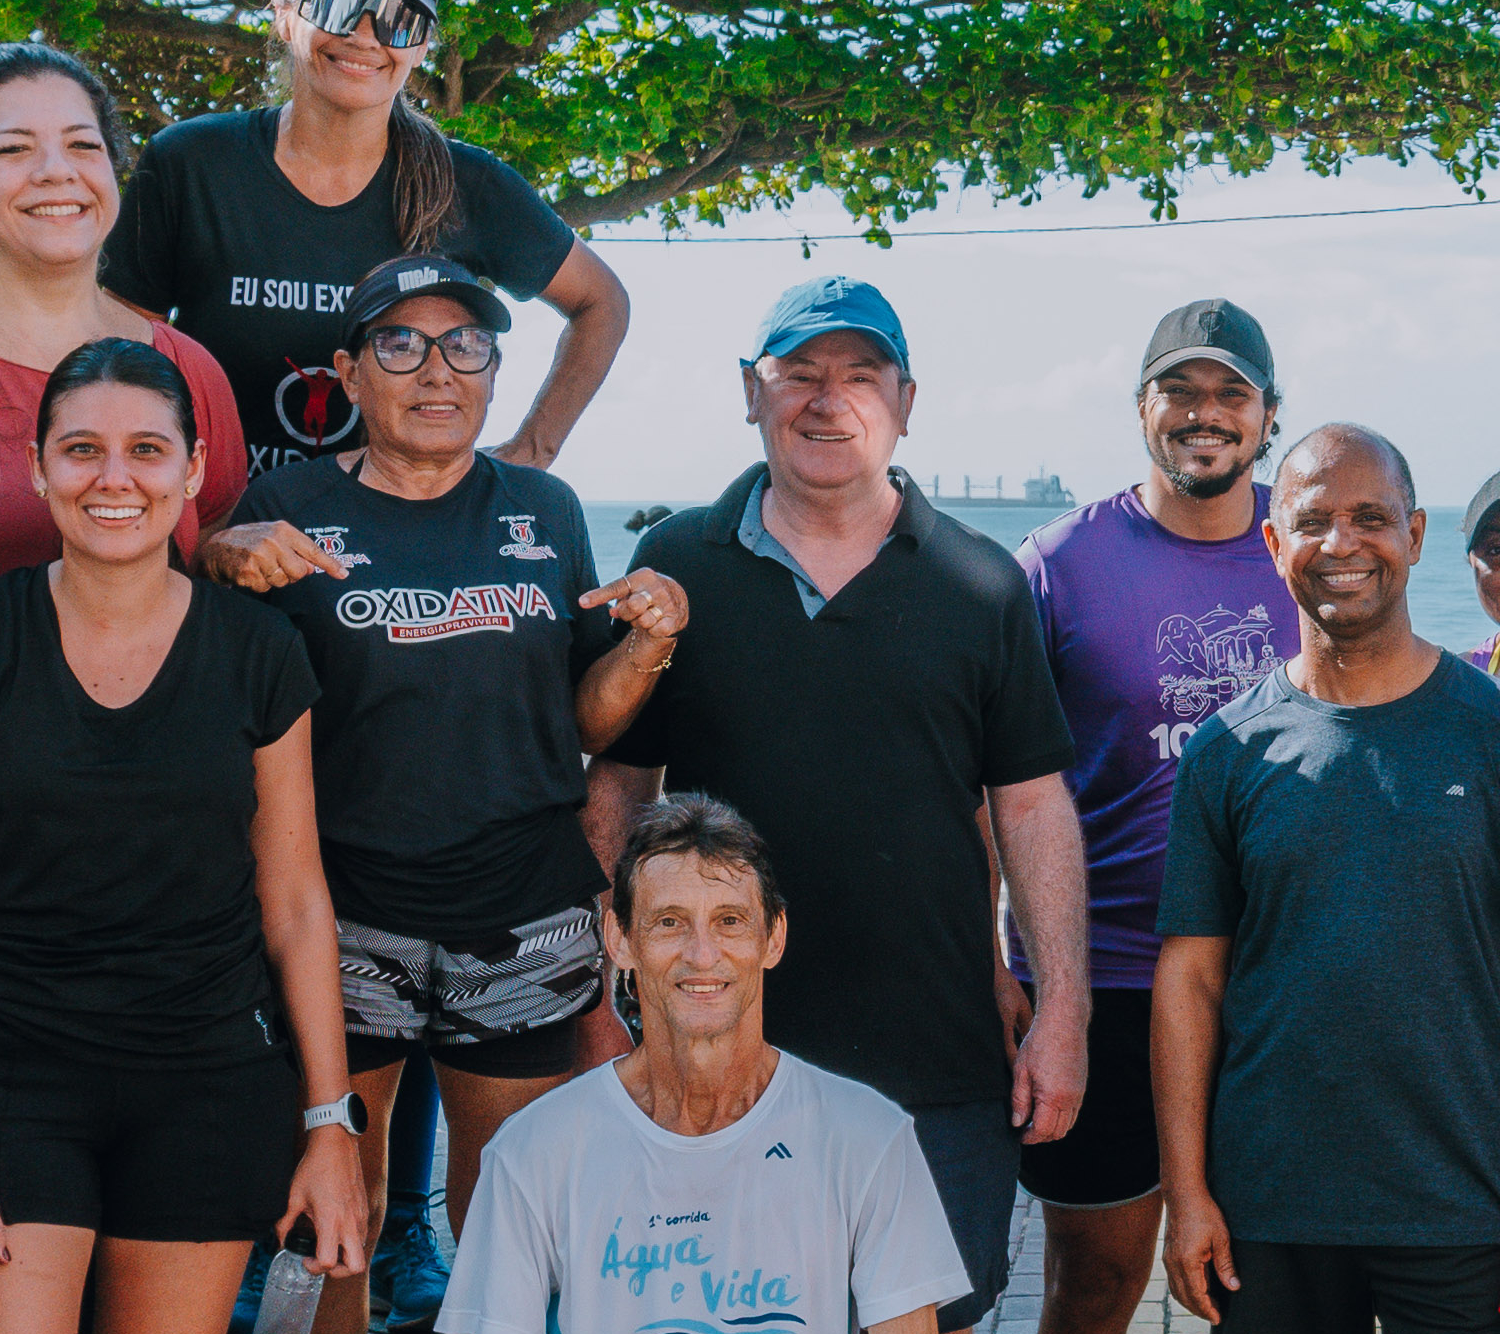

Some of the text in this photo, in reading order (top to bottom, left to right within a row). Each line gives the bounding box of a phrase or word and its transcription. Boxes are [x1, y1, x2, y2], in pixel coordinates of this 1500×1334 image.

[230, 276, 354, 313] EU SOU EX
[336, 583, 556, 629] OXIDATIVA
[399, 626, 445, 638] ENERGIA
[1149, 722, 1204, 760] 10
[665, 1211, 711, 1226] corrida
[601, 1216, 715, 1297] Água
[671, 1269, 801, 1315] e Vida
